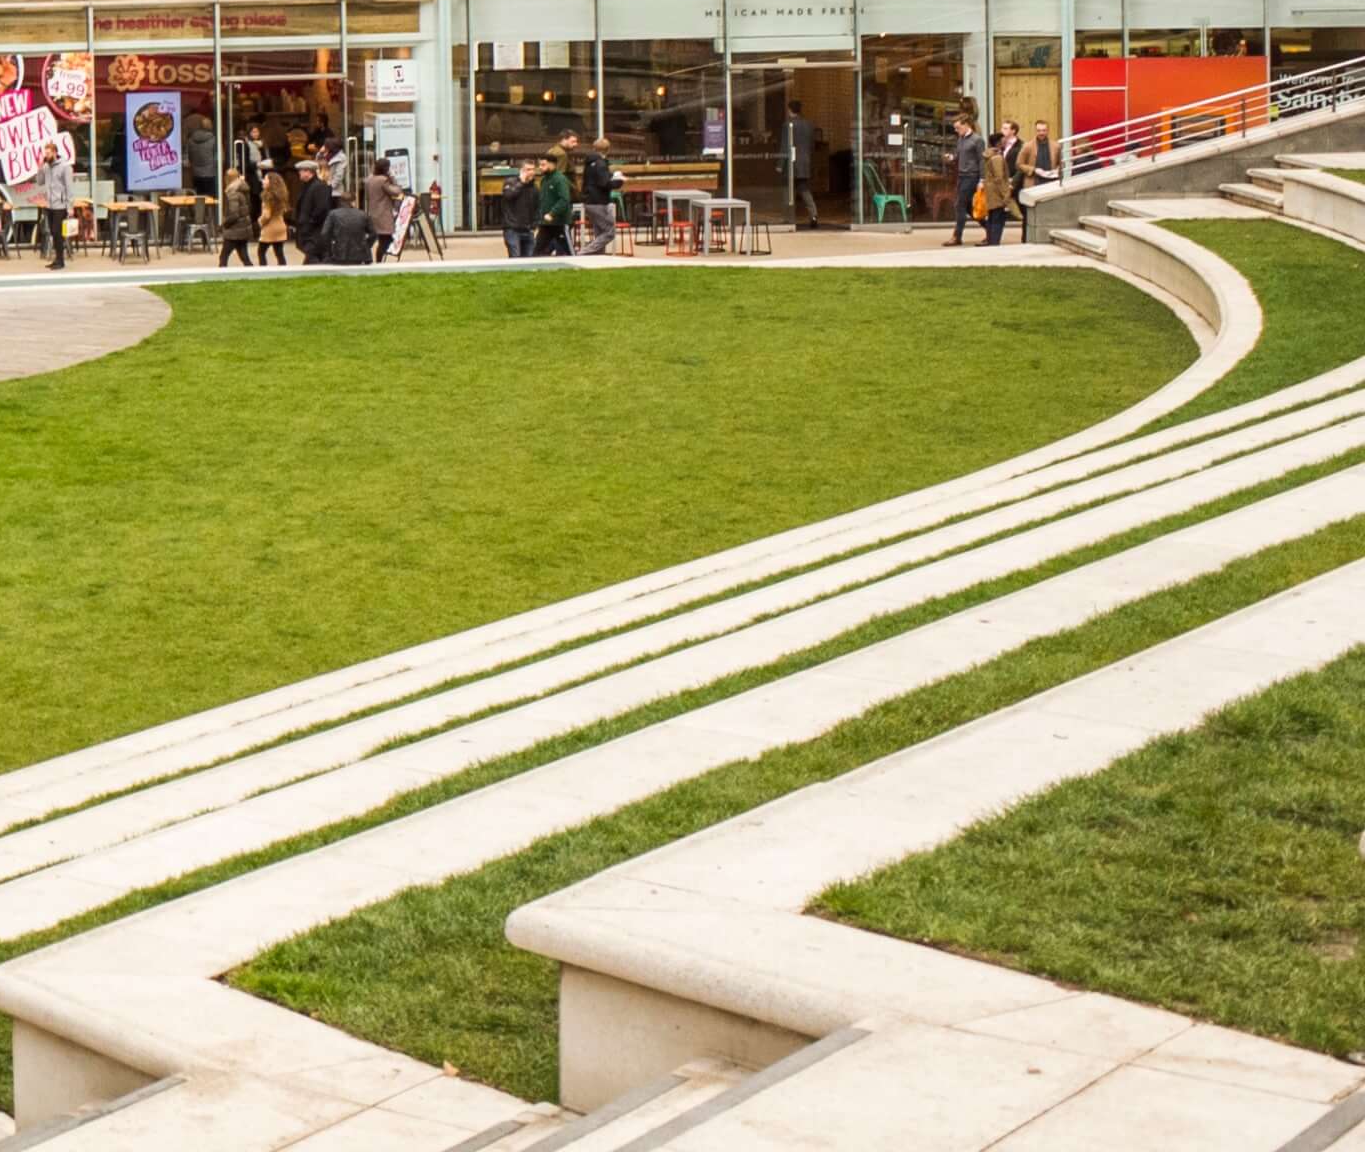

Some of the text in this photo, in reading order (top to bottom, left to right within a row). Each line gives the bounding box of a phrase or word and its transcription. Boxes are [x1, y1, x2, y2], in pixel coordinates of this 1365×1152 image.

[92, 13, 113, 31] he
[116, 13, 186, 30] healthier
[243, 12, 287, 29] place
[704, 8, 768, 17] MEICAN
[776, 7, 814, 16] MADE
[8, 135, 72, 182] BOWS
